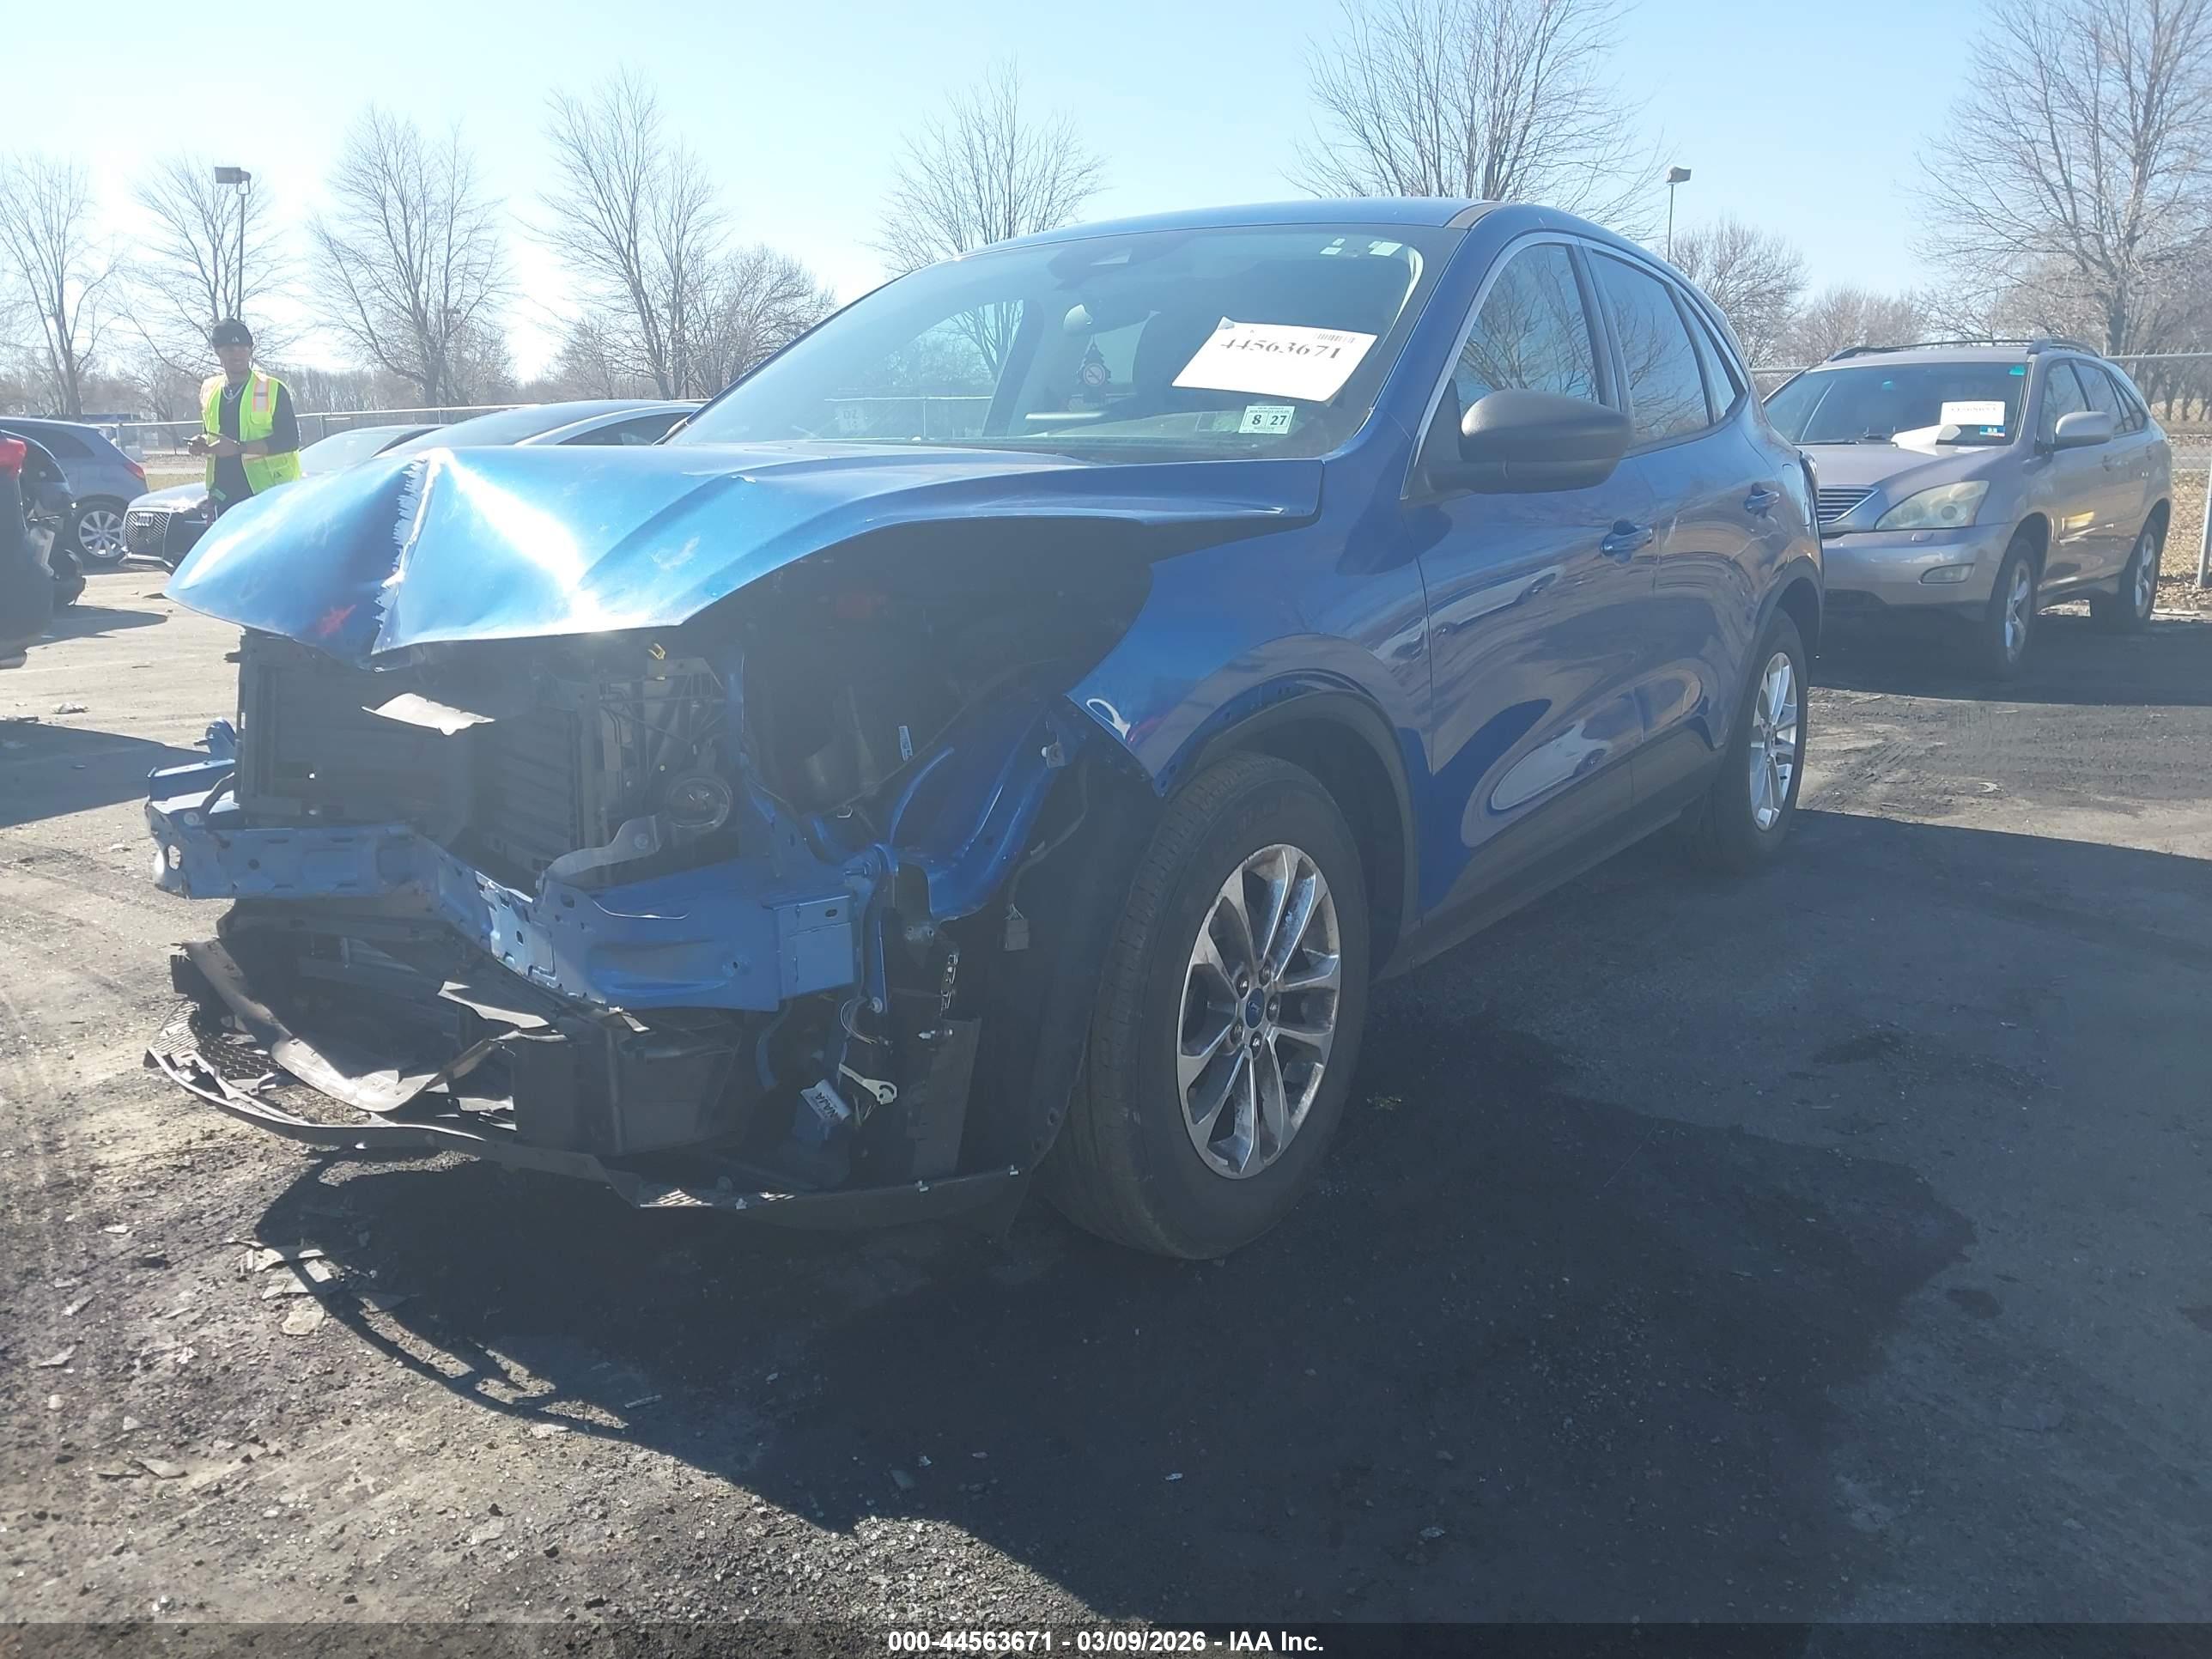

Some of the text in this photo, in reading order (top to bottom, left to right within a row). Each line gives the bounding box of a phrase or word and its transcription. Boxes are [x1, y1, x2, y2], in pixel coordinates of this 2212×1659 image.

[1220, 338, 1341, 359] 44563671
[1252, 414, 1287, 426] 8 27
